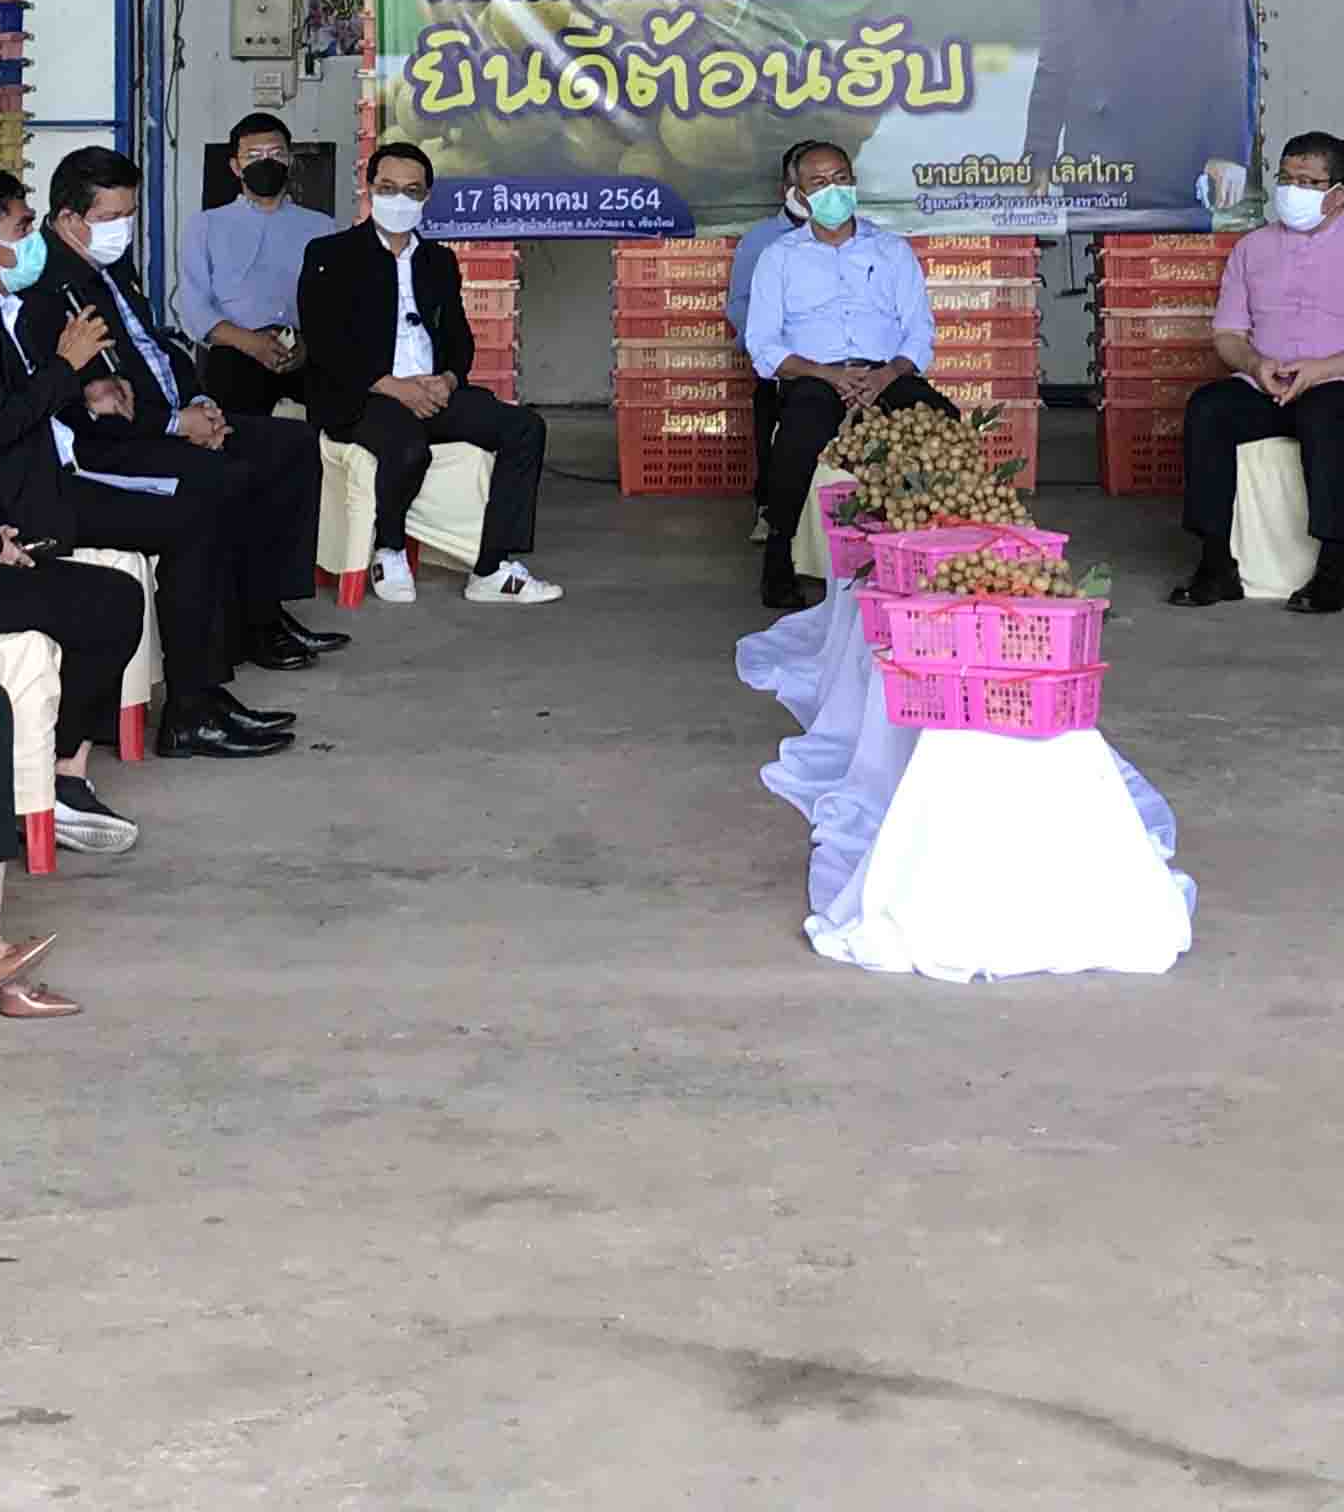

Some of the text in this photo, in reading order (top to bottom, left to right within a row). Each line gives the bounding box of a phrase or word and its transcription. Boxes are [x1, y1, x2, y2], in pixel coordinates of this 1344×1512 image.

[412, 10, 966, 113] ยินดีต้อนฮับ
[913, 153, 1135, 186] นายสินิตย์ เลิศไกร
[453, 184, 662, 212] 17 สิงหาคม 2564
